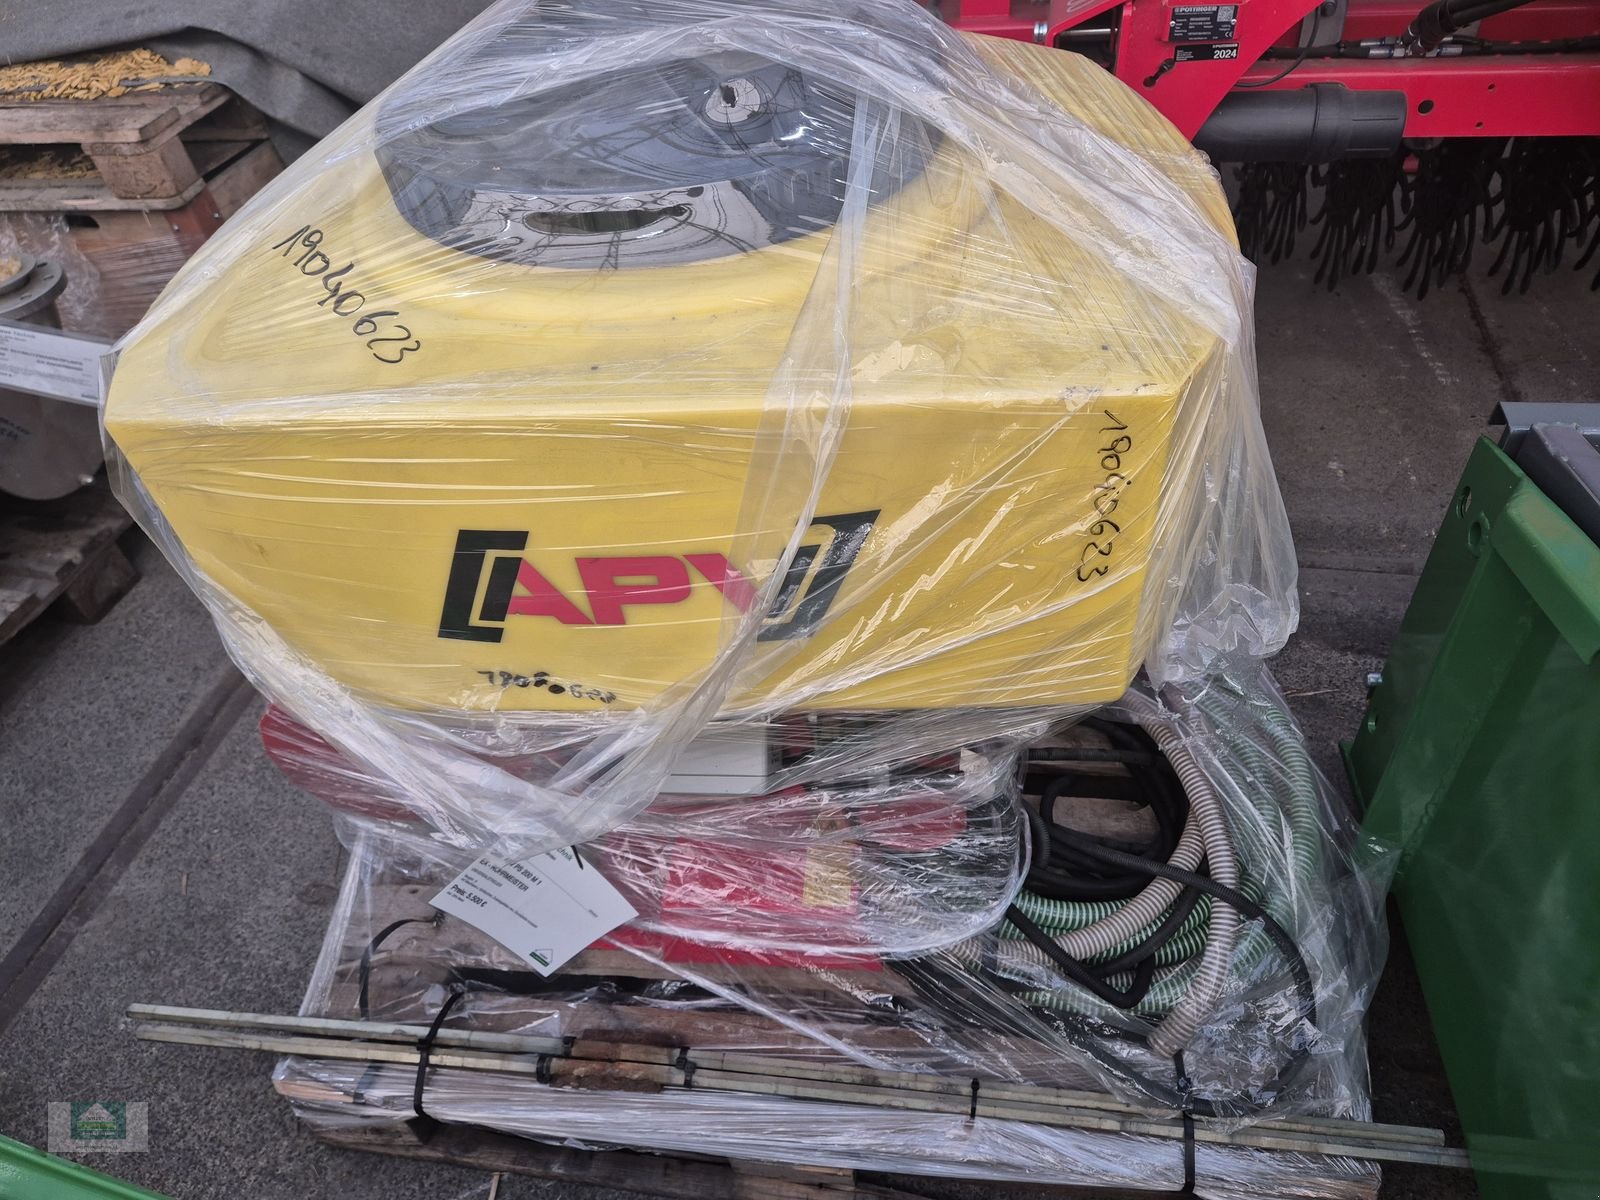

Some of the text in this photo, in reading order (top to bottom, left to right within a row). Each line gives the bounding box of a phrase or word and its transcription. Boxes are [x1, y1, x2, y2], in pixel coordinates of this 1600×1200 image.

[1214, 49, 1237, 59] 2024
[272, 224, 421, 364] 19040623
[1077, 410, 1132, 583] 19040623
[521, 868, 533, 879] 200
[465, 892, 482, 905] 5.500
